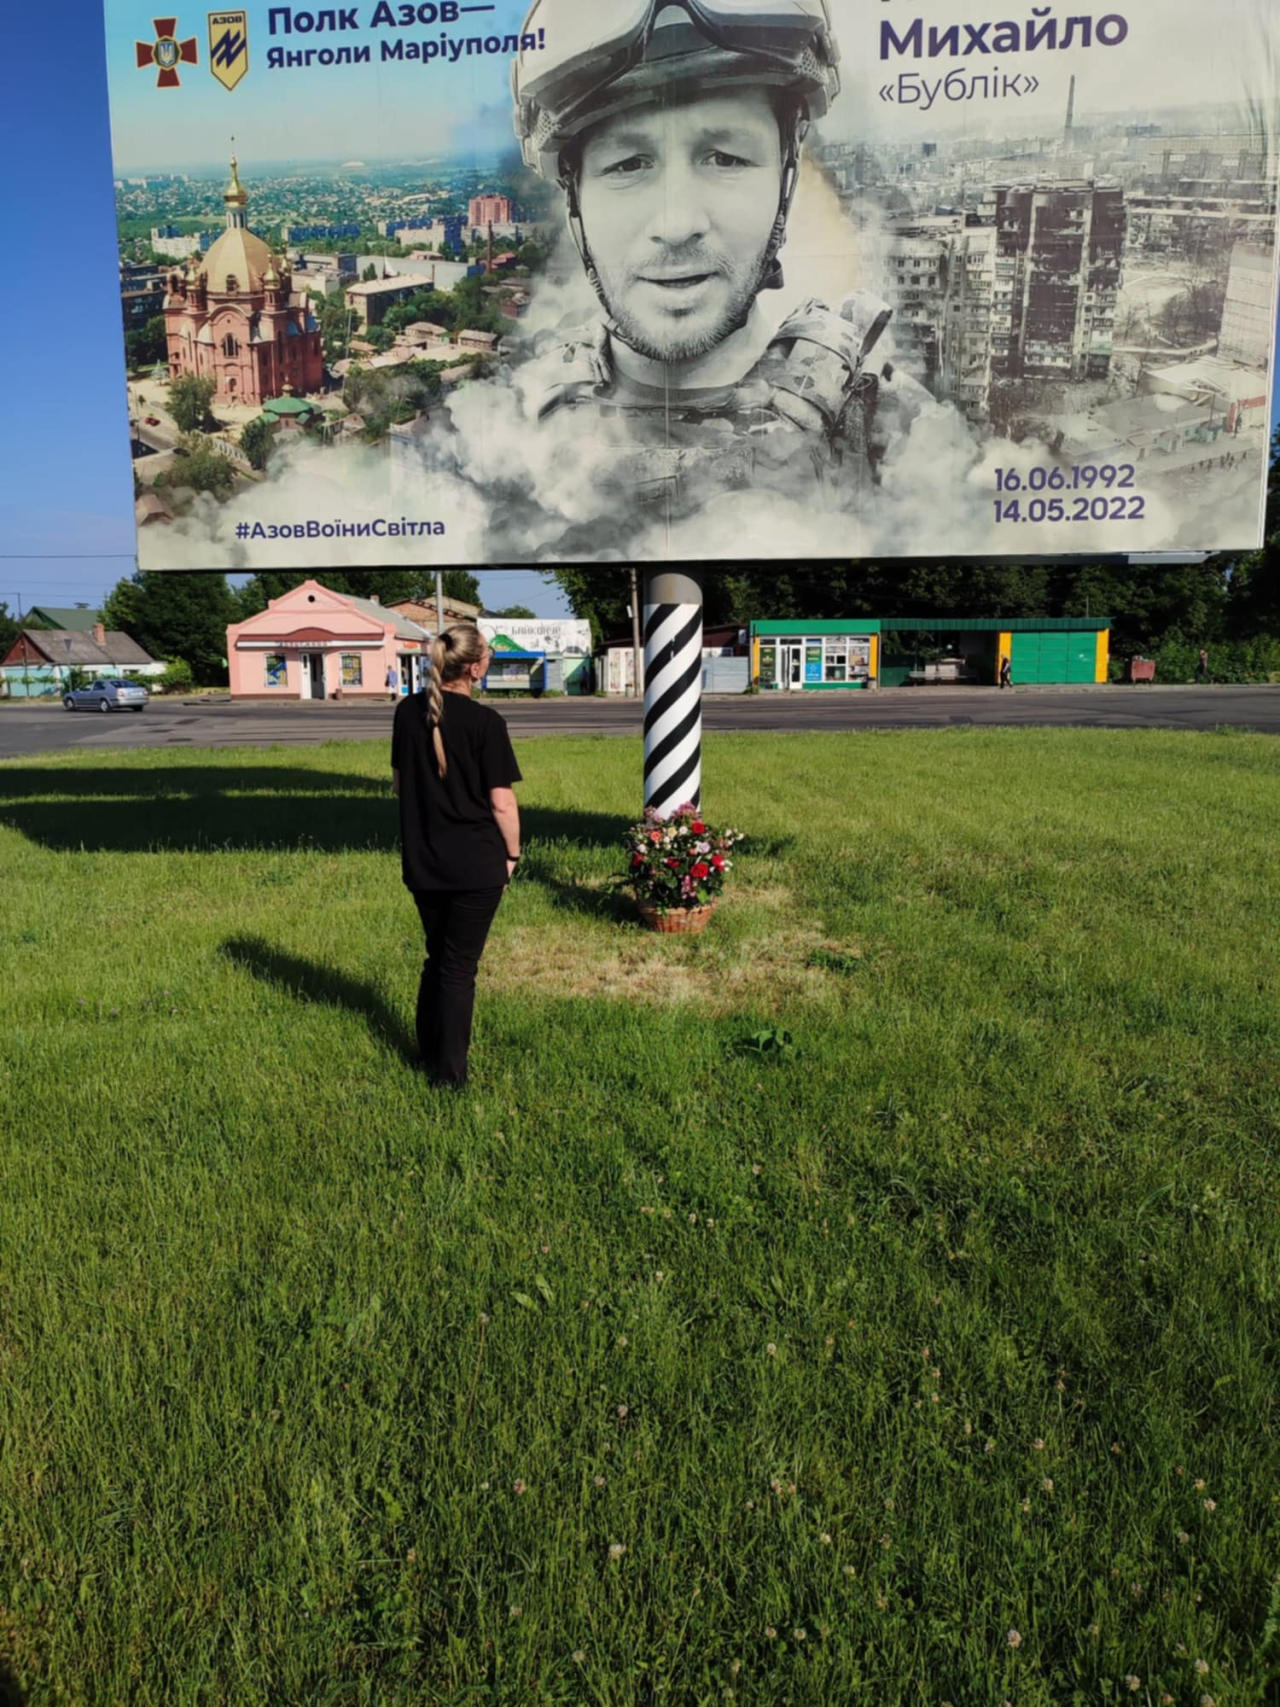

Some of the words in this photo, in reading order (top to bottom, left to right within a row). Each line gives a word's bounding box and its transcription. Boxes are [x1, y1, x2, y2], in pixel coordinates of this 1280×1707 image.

[212, 15, 242, 25] АЗОВ
[268, 7, 359, 35] Полк
[880, 6, 1129, 59] Михайло
[267, 45, 370, 69] Янголи
[380, 28, 546, 64] Маріуполя!
[878, 66, 1040, 111] «Бублік»
[994, 464, 1135, 492] 16.06.1992
[993, 495, 1145, 523] 14.05.2022
[235, 516, 445, 540] #АзовВоїниСвітла
